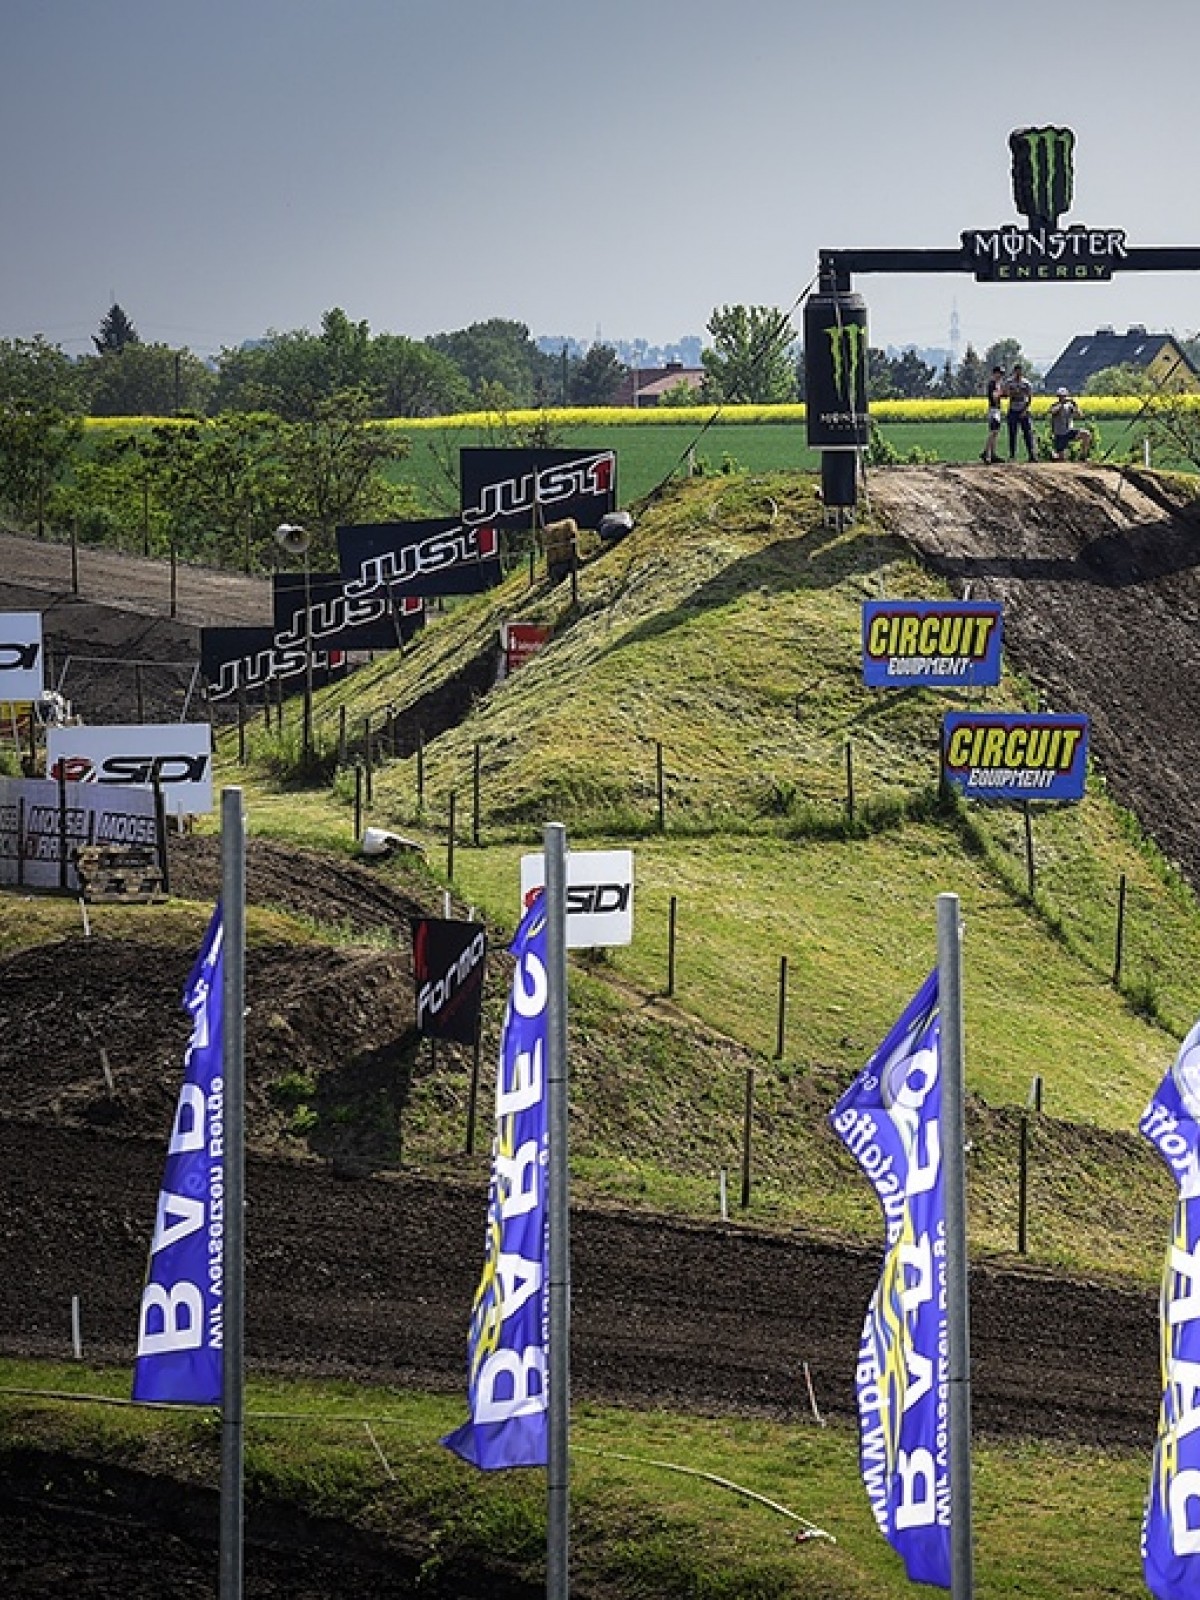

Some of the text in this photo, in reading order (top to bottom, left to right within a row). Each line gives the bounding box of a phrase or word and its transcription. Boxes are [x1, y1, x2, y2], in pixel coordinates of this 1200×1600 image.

[975, 228, 1127, 261] MONSTER
[999, 265, 1105, 277] ENERGY
[868, 616, 994, 657] CIRCUIT
[887, 658, 971, 675] EQUIPMENT
[948, 728, 1081, 768] CIRCUIT
[968, 769, 1056, 787] EQUIPMENT
